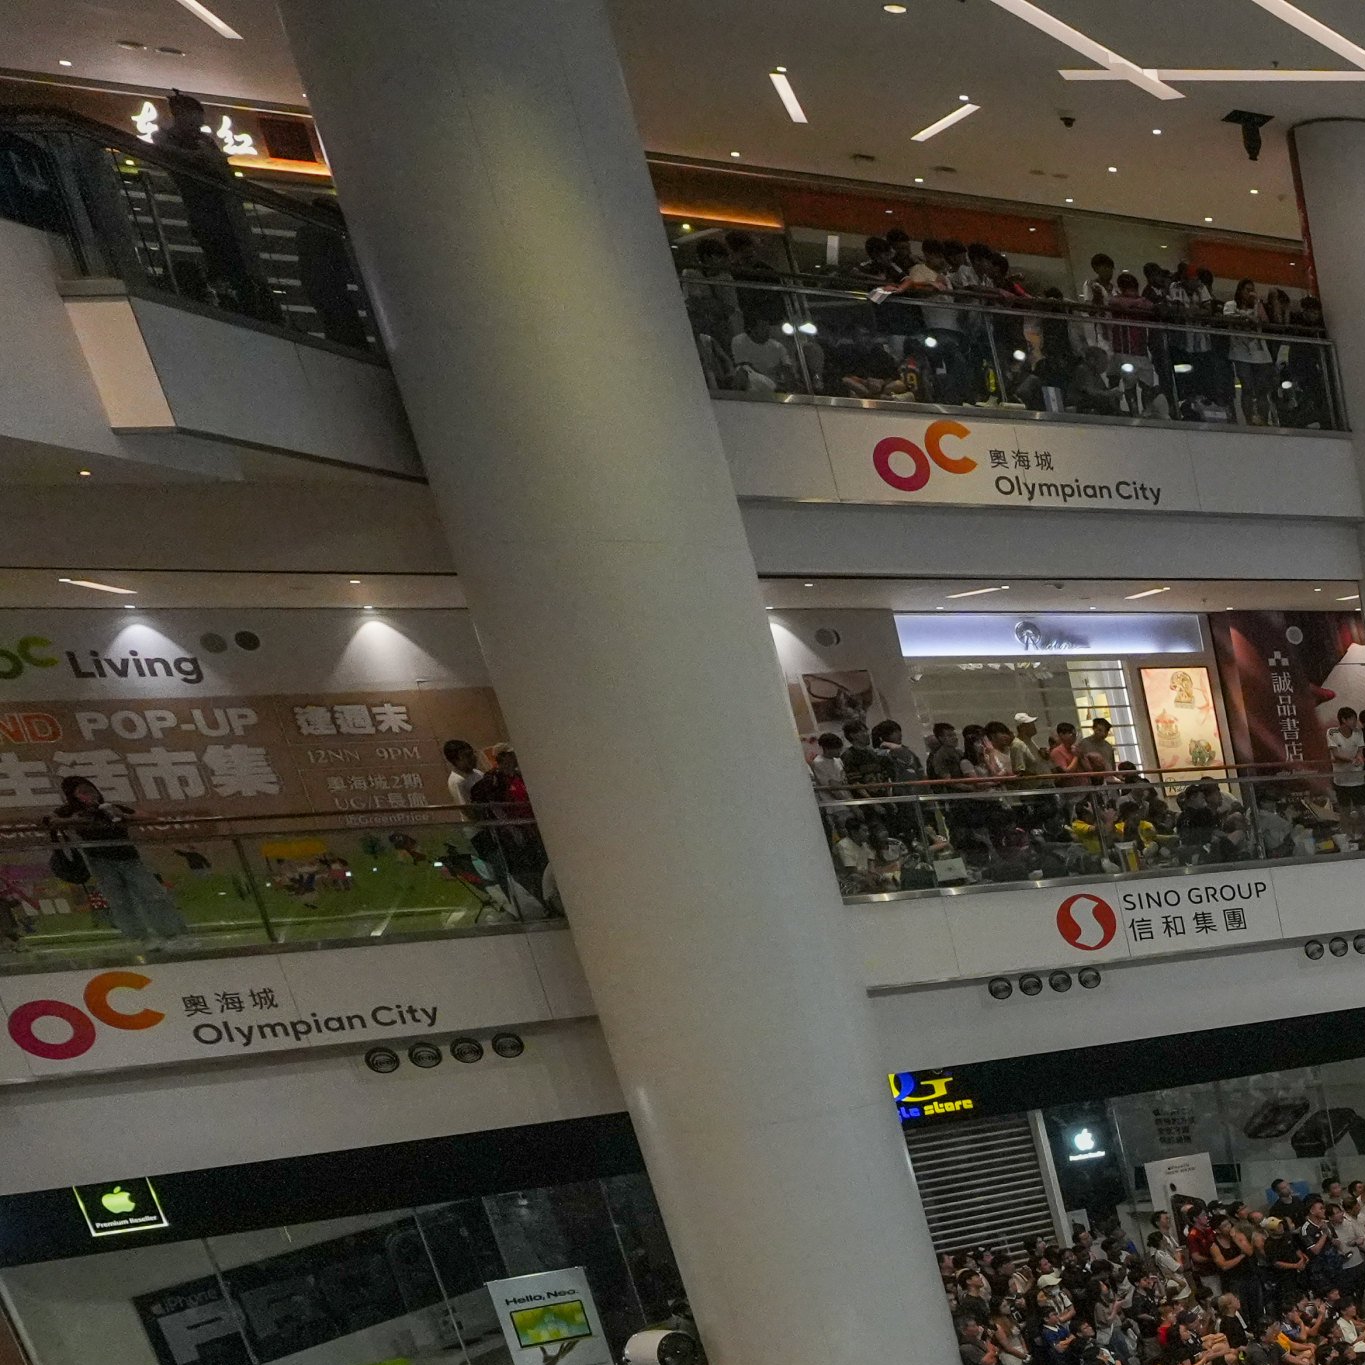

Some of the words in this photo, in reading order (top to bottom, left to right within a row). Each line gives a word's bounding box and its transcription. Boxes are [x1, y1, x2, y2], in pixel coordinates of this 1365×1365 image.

[873, 419, 977, 492] OC
[989, 448, 1054, 472] 奧海城
[995, 474, 1113, 502] Olympian
[1116, 480, 1161, 506] City
[65, 650, 204, 683] Living
[77, 706, 258, 742] POP-UP
[1272, 671, 1306, 763] 誠品書店
[1122, 888, 1181, 912] SINO
[1186, 881, 1268, 905] GROUP
[1127, 906, 1248, 944] 信和集團
[6, 968, 167, 1060] OC
[181, 986, 280, 1017] 奧海城
[193, 1010, 368, 1046] Olympian
[370, 1001, 439, 1033] City
[924, 1099, 974, 1117] store
[96, 1217, 129, 1230] Premium
[130, 1213, 158, 1226] Reseller
